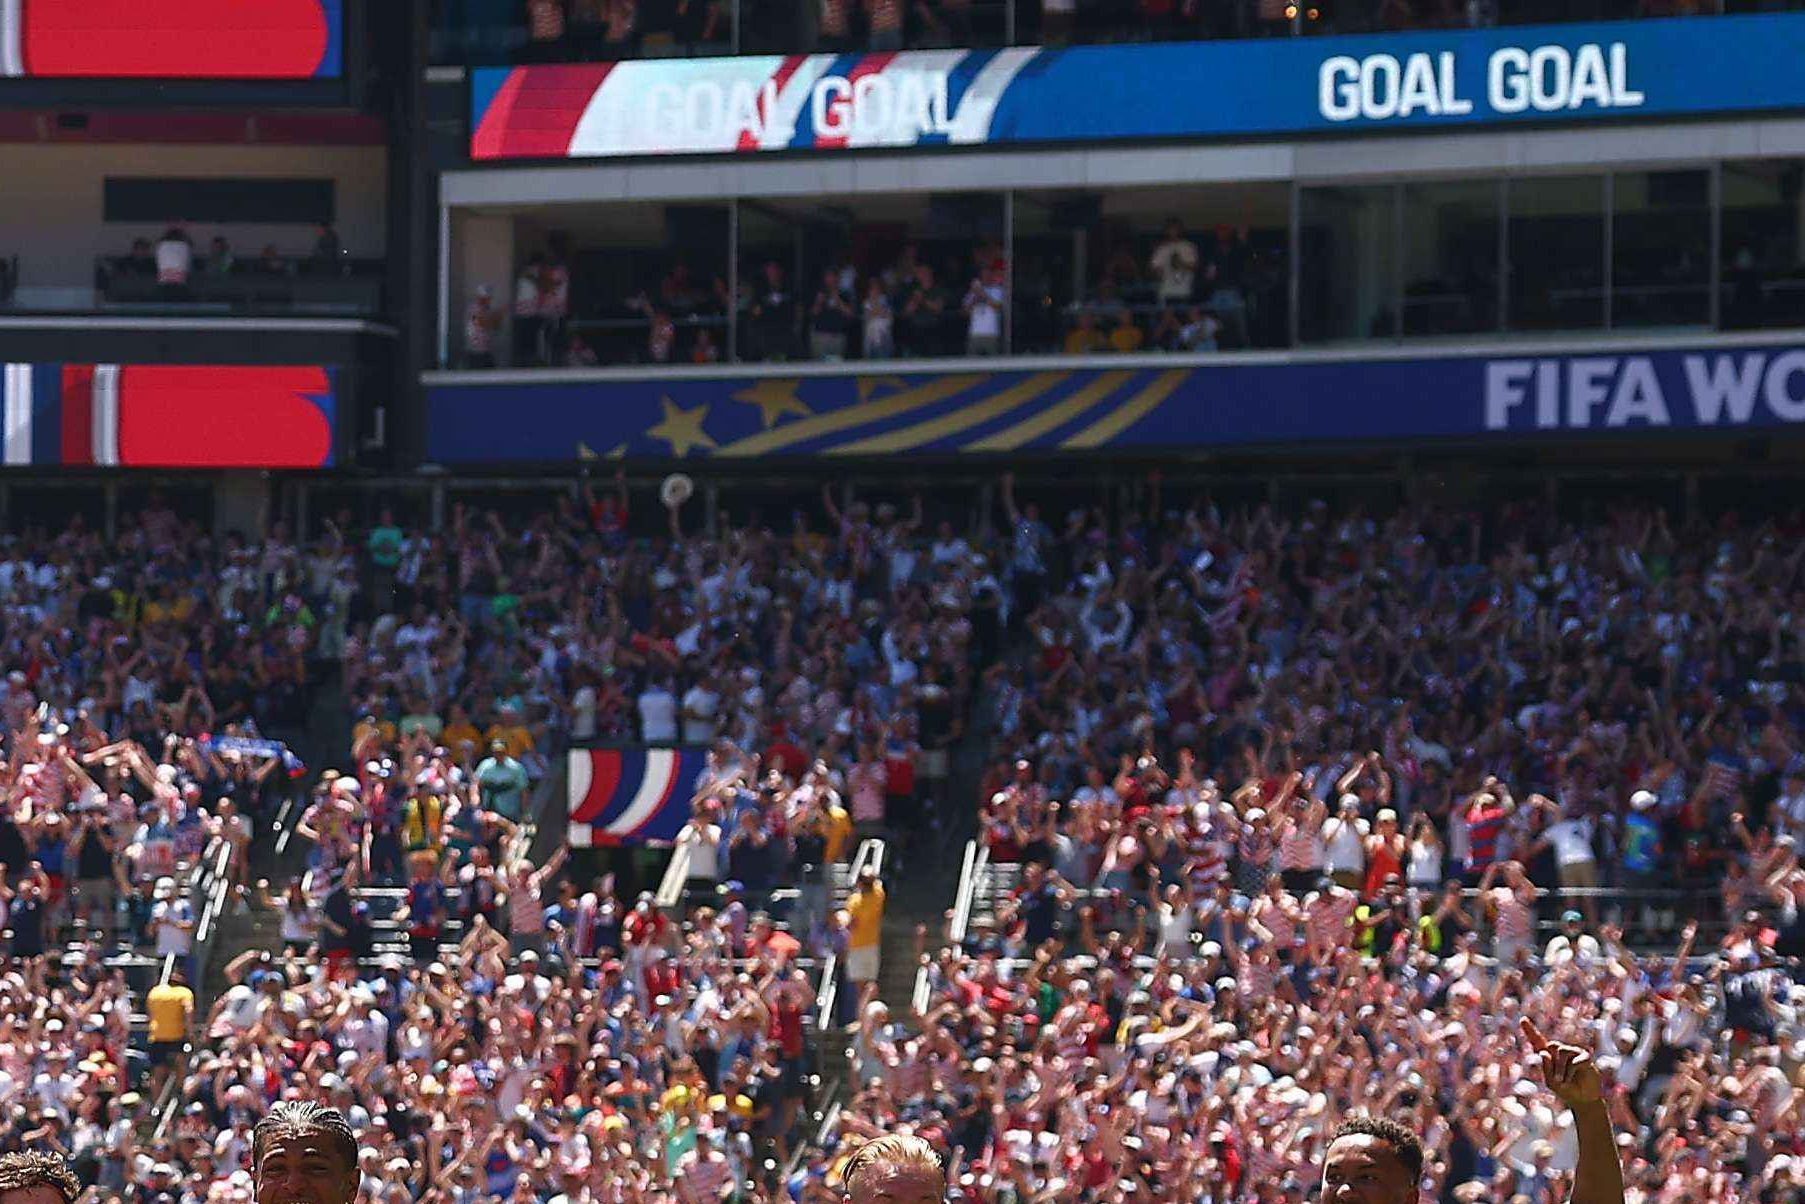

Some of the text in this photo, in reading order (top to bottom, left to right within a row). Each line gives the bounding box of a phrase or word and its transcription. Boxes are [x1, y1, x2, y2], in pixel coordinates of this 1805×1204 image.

[646, 69, 967, 139] GOAL GOAL
[1318, 42, 1645, 121] GOAL GOAL
[1485, 356, 1671, 430] FIFA
